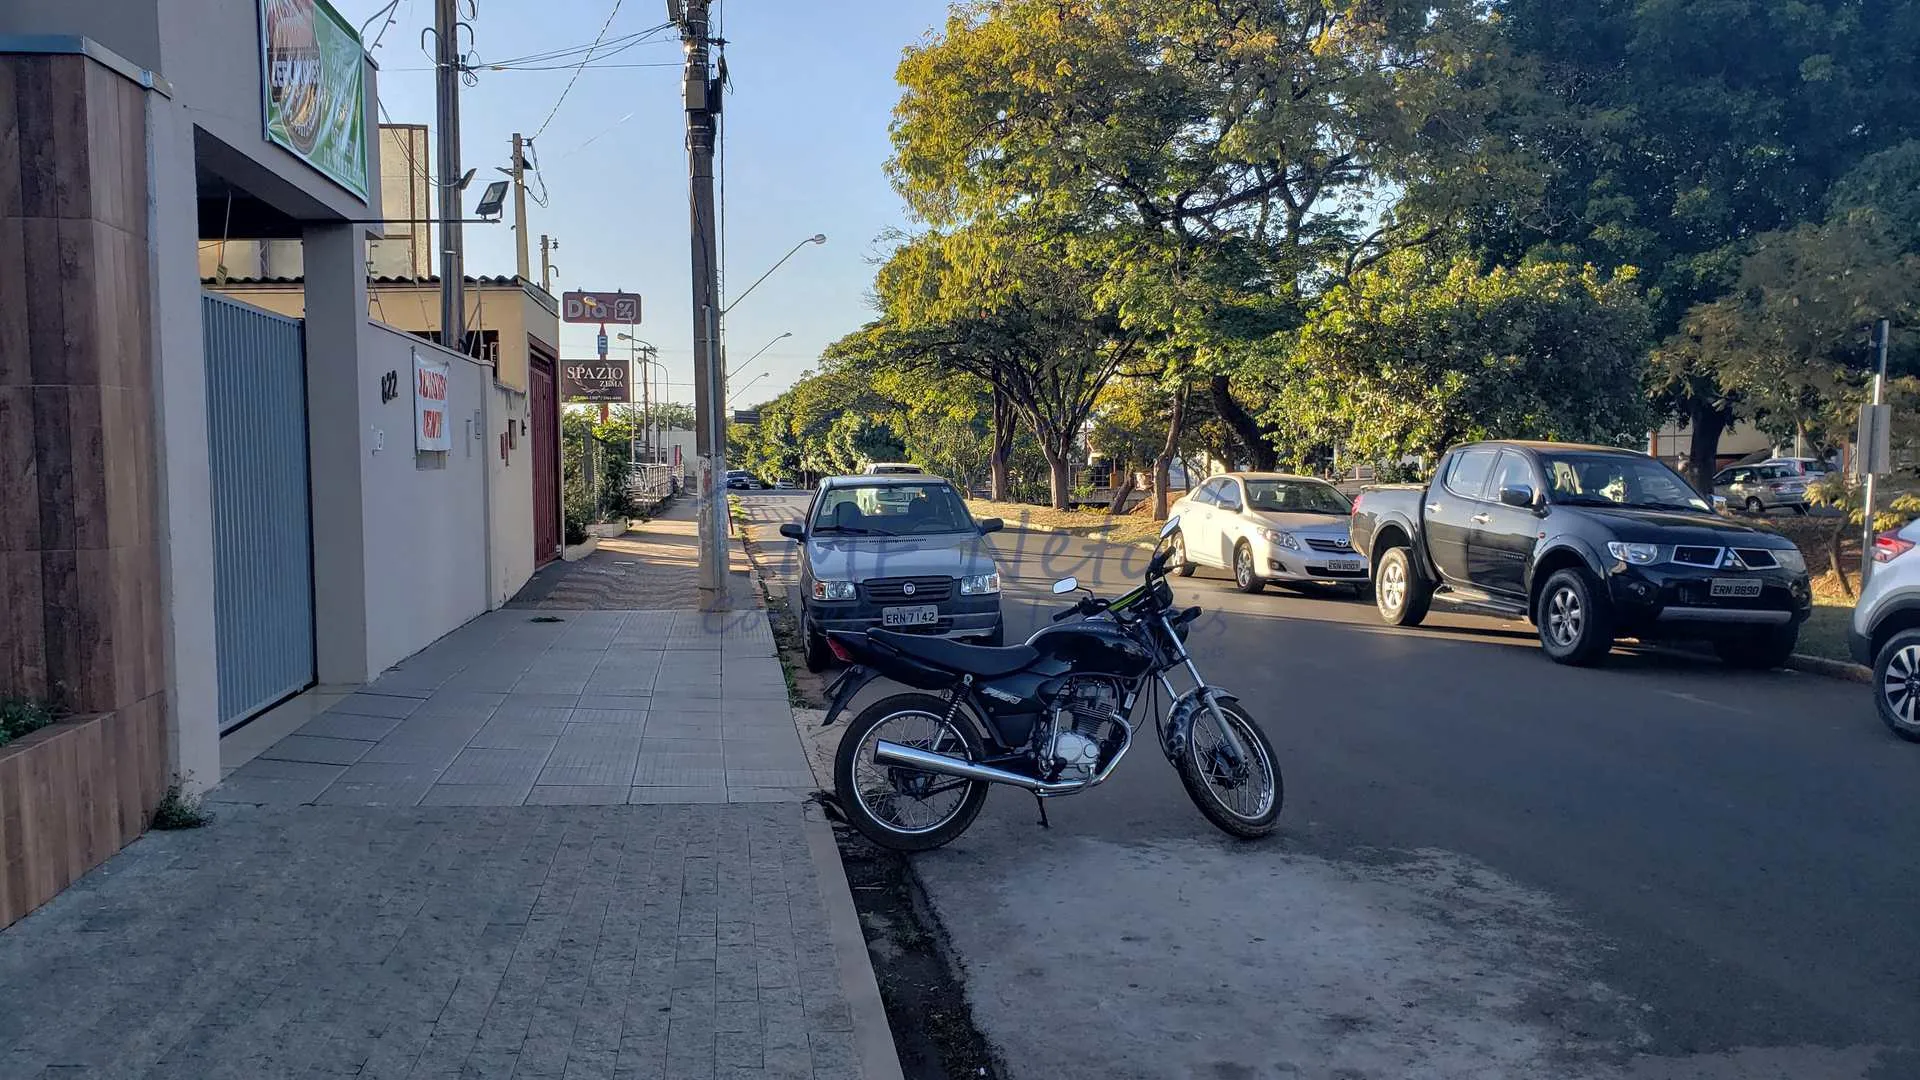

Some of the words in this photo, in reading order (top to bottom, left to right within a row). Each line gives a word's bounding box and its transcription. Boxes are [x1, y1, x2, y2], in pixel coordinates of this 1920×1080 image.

[567, 366, 624, 380] SPAZIO
[600, 380, 624, 388] ZEMA
[908, 612, 935, 623] 7142
